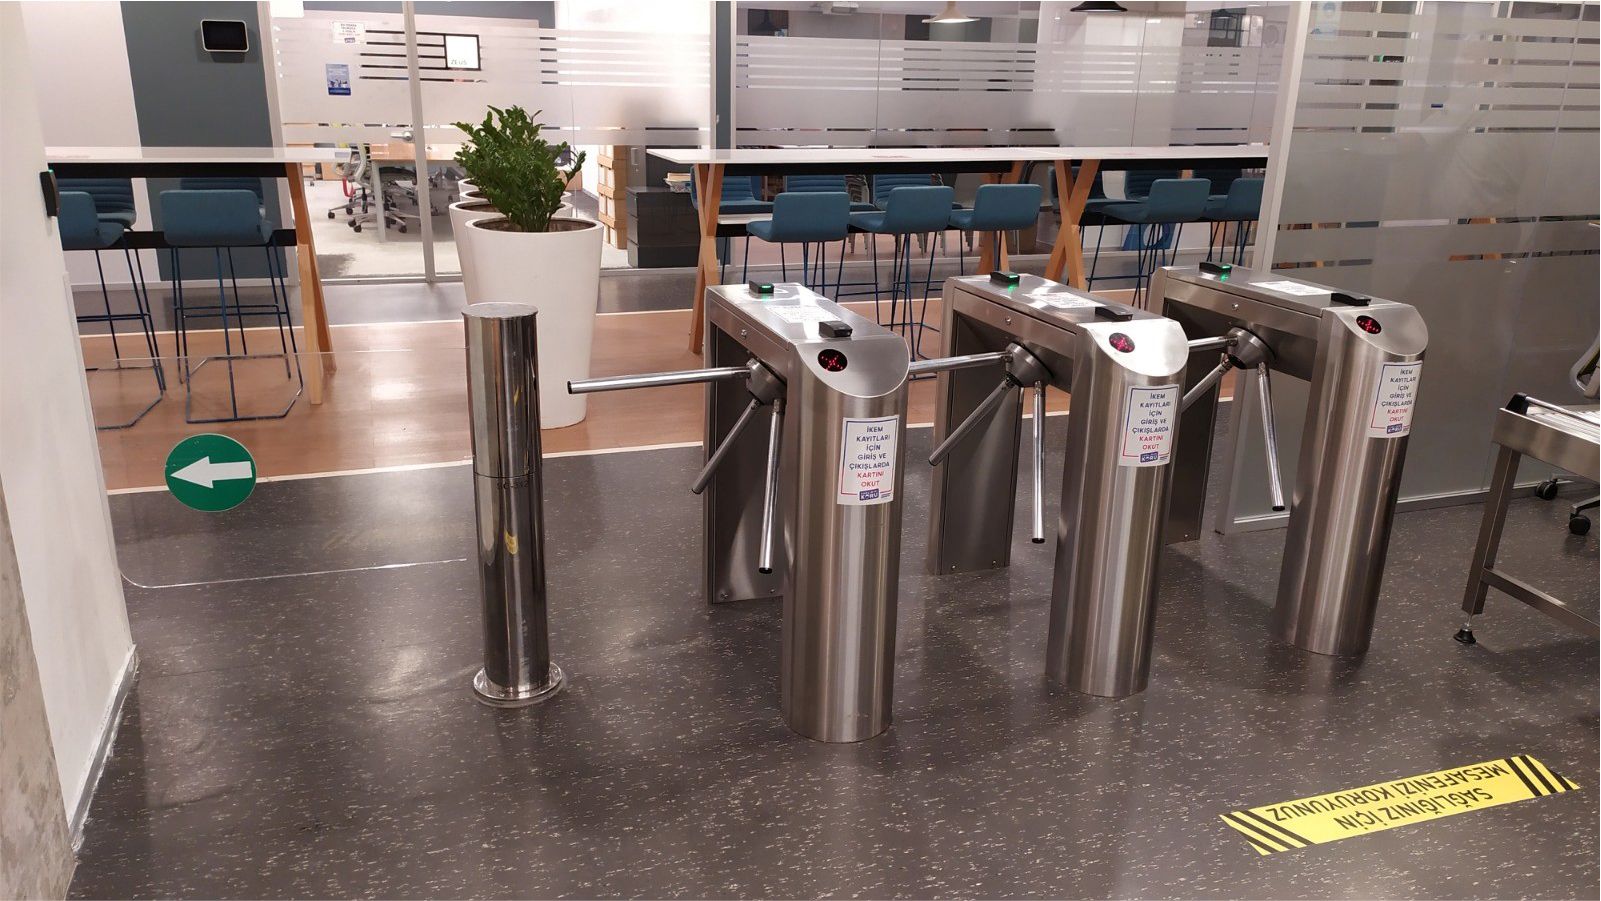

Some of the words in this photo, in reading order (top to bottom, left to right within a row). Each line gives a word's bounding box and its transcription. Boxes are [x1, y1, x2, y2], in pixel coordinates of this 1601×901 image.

[1132, 426, 1169, 435] ÇIKIŞLARDA
[849, 462, 890, 471] ÇIKIŞLARDA
[1391, 763, 1510, 797] MESAFENİZİ
[1266, 784, 1390, 822] KORUYUNUZ
[1387, 787, 1492, 822] SAĞLIĞINIZ
[1336, 806, 1385, 831] İÇİN
